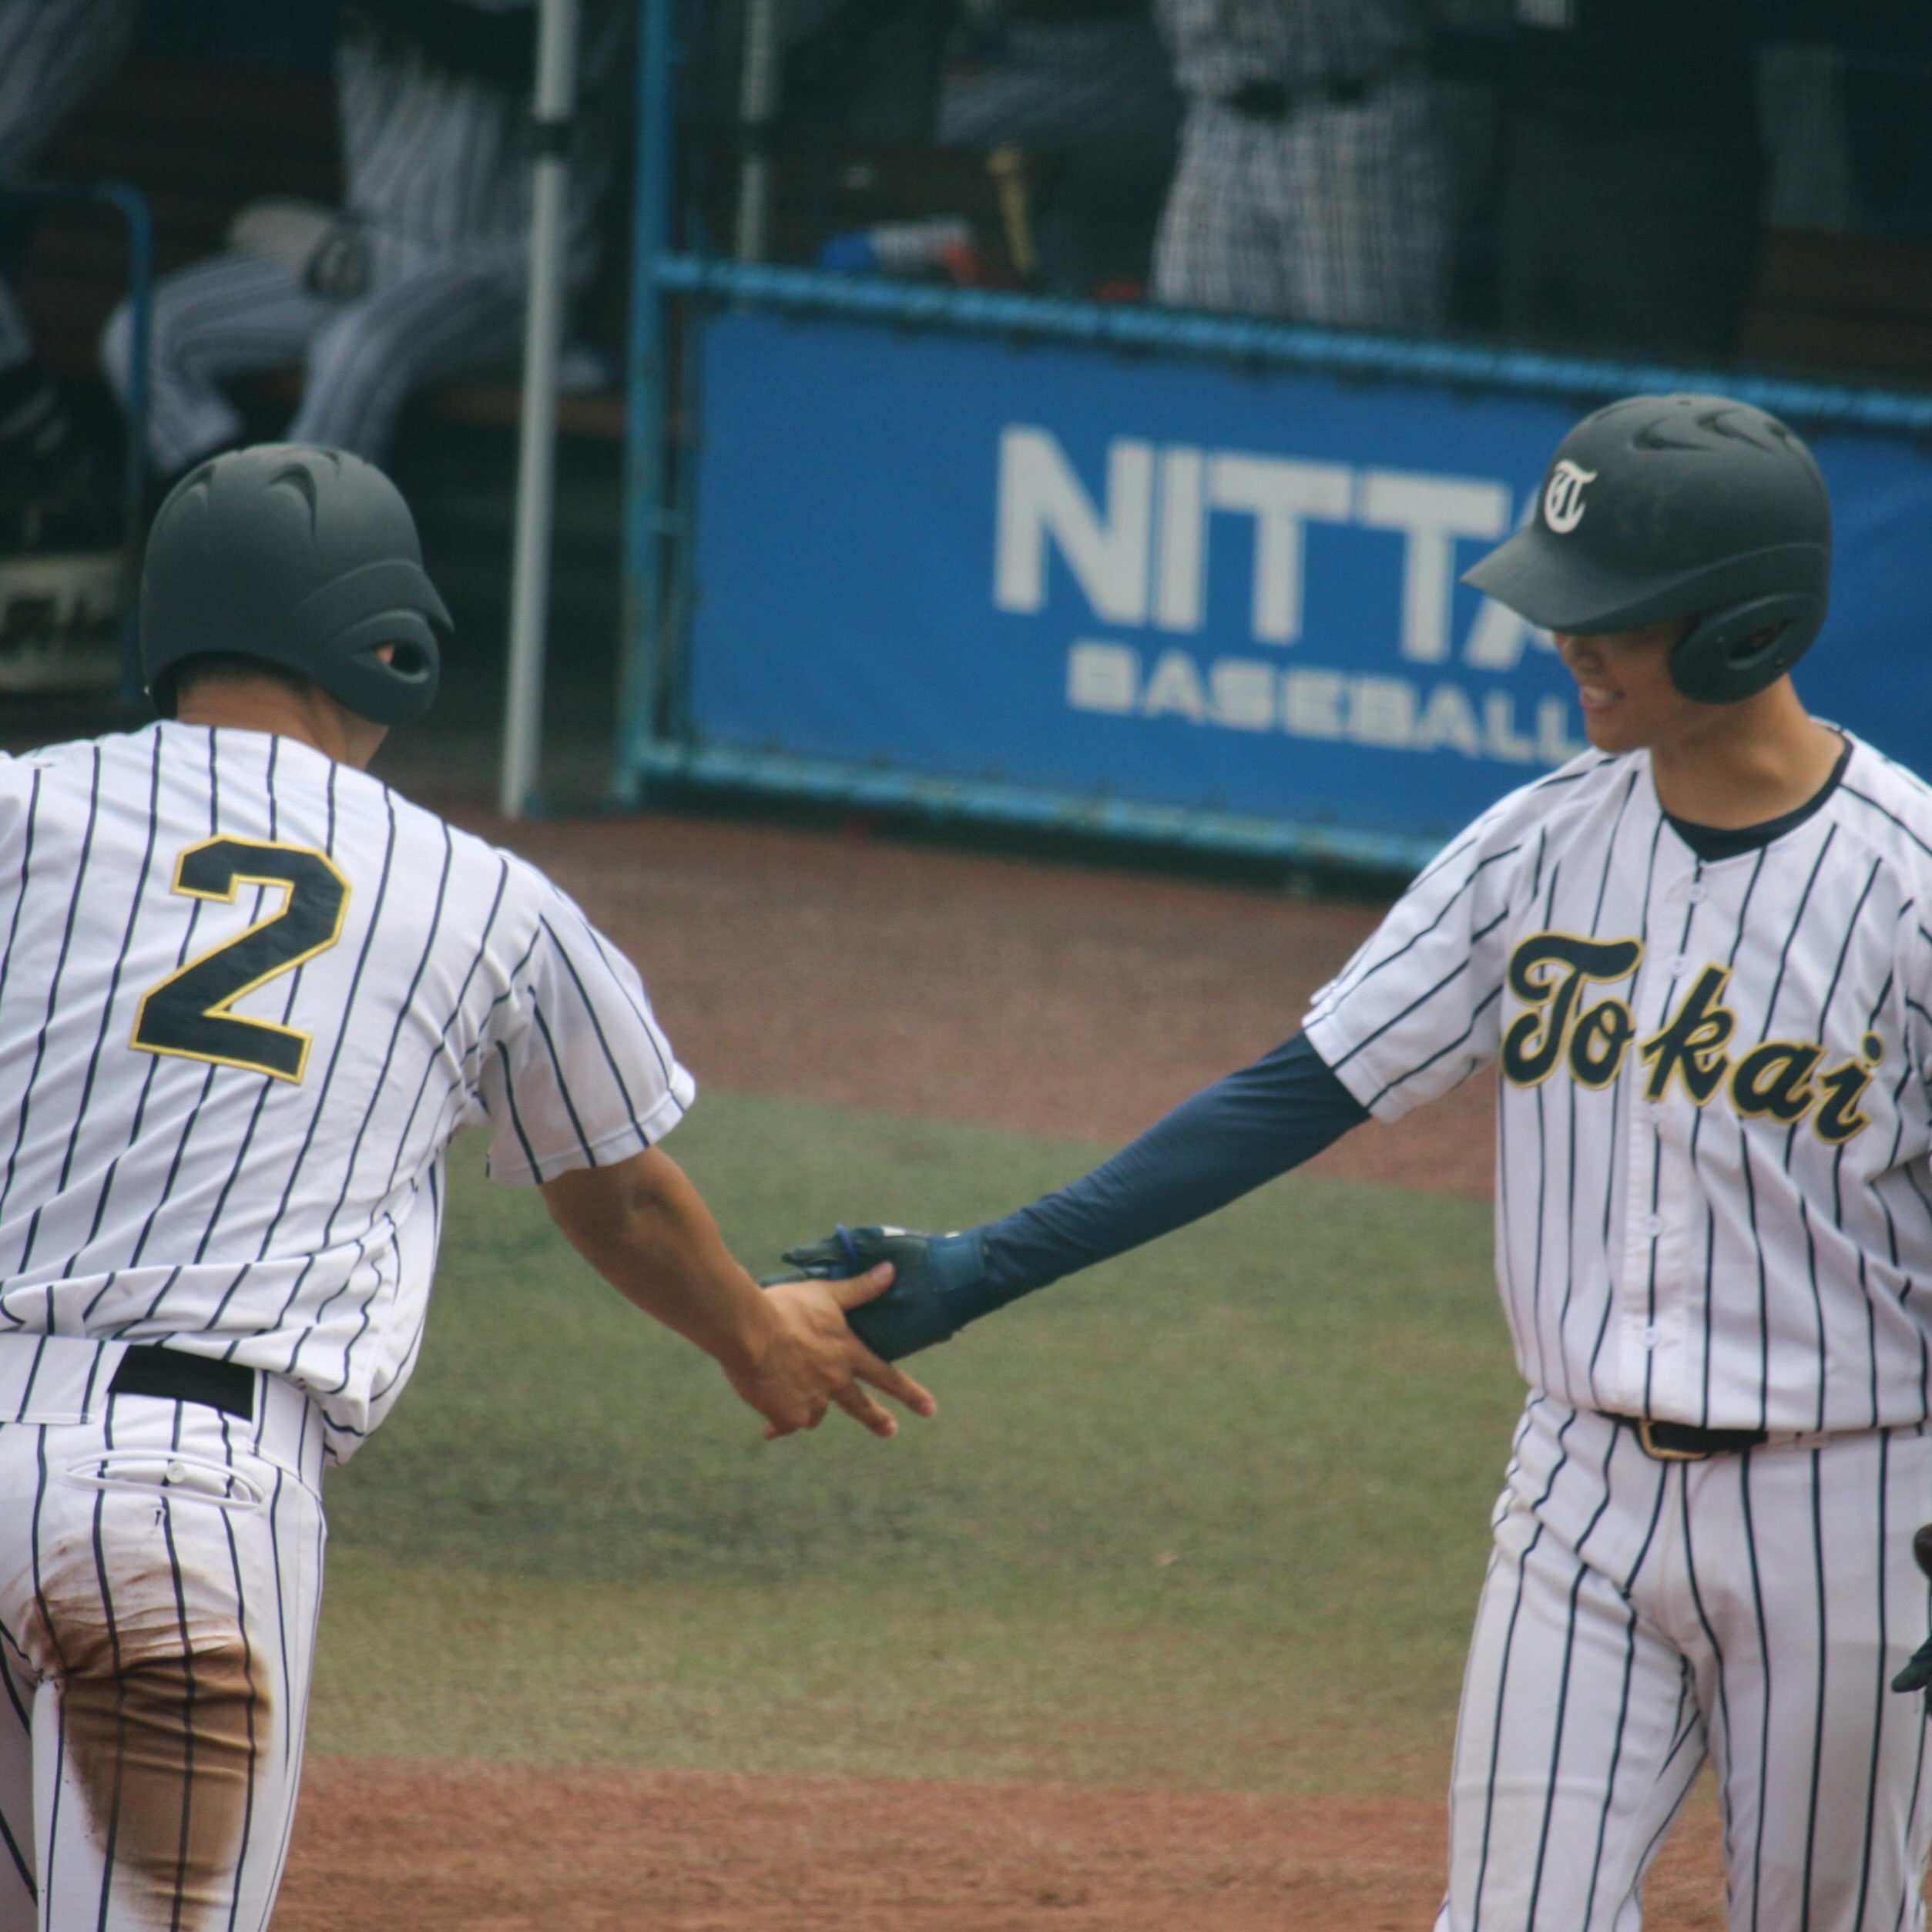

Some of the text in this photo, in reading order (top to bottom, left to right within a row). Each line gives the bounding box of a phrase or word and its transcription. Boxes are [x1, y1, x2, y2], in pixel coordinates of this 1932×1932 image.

[1068, 640, 1584, 765] BASEBALL
[129, 833, 353, 1086] 2
[1502, 931, 1884, 1145] Tokai
